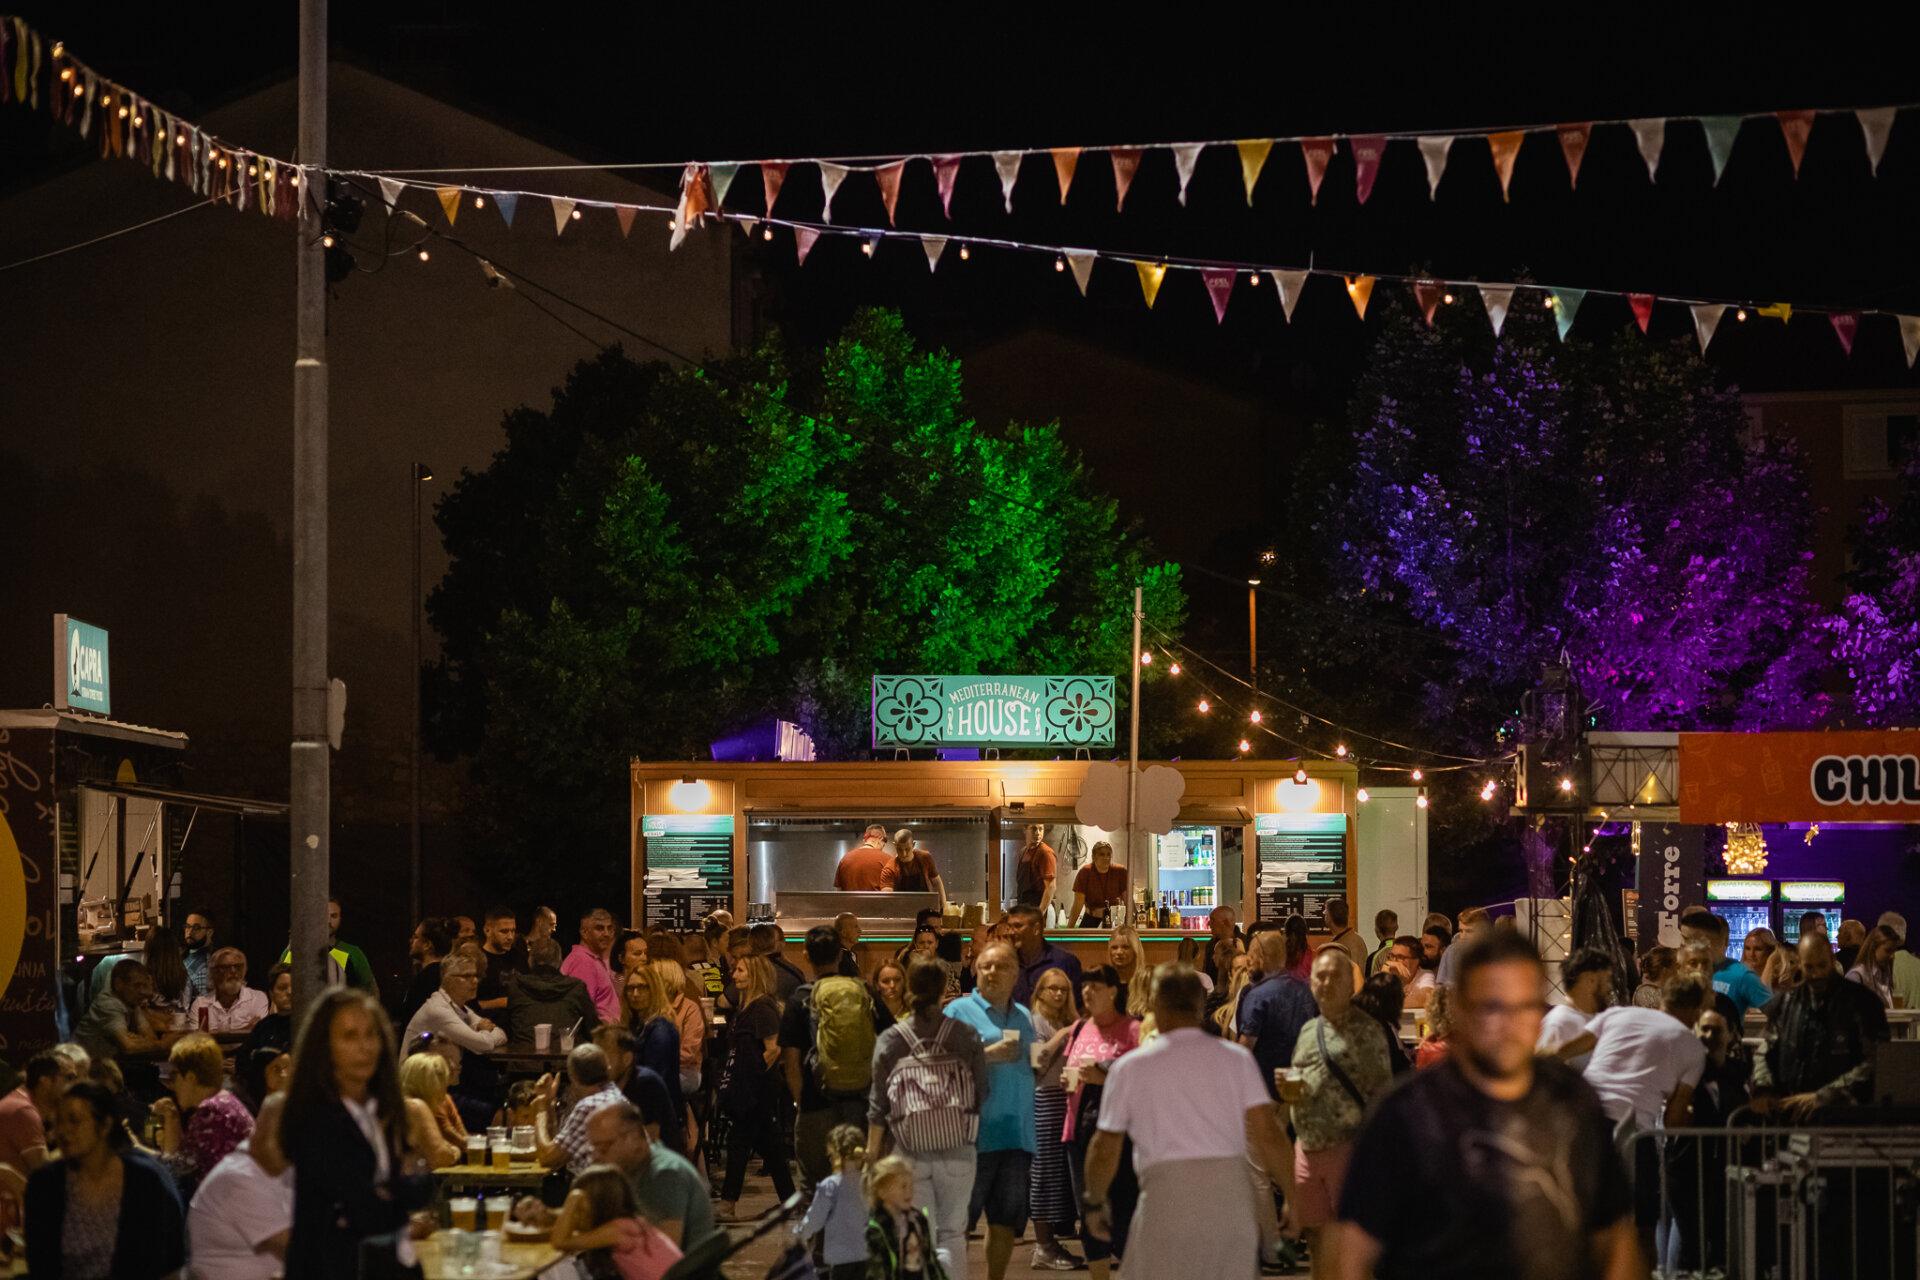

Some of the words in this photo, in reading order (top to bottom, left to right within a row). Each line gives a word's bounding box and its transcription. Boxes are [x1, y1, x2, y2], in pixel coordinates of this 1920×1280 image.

[80, 645, 103, 685] CAPRA
[948, 683, 1041, 704] MEDITERRANEAN
[957, 699, 1031, 736] HOUSE
[1811, 755, 1920, 805] CHIL
